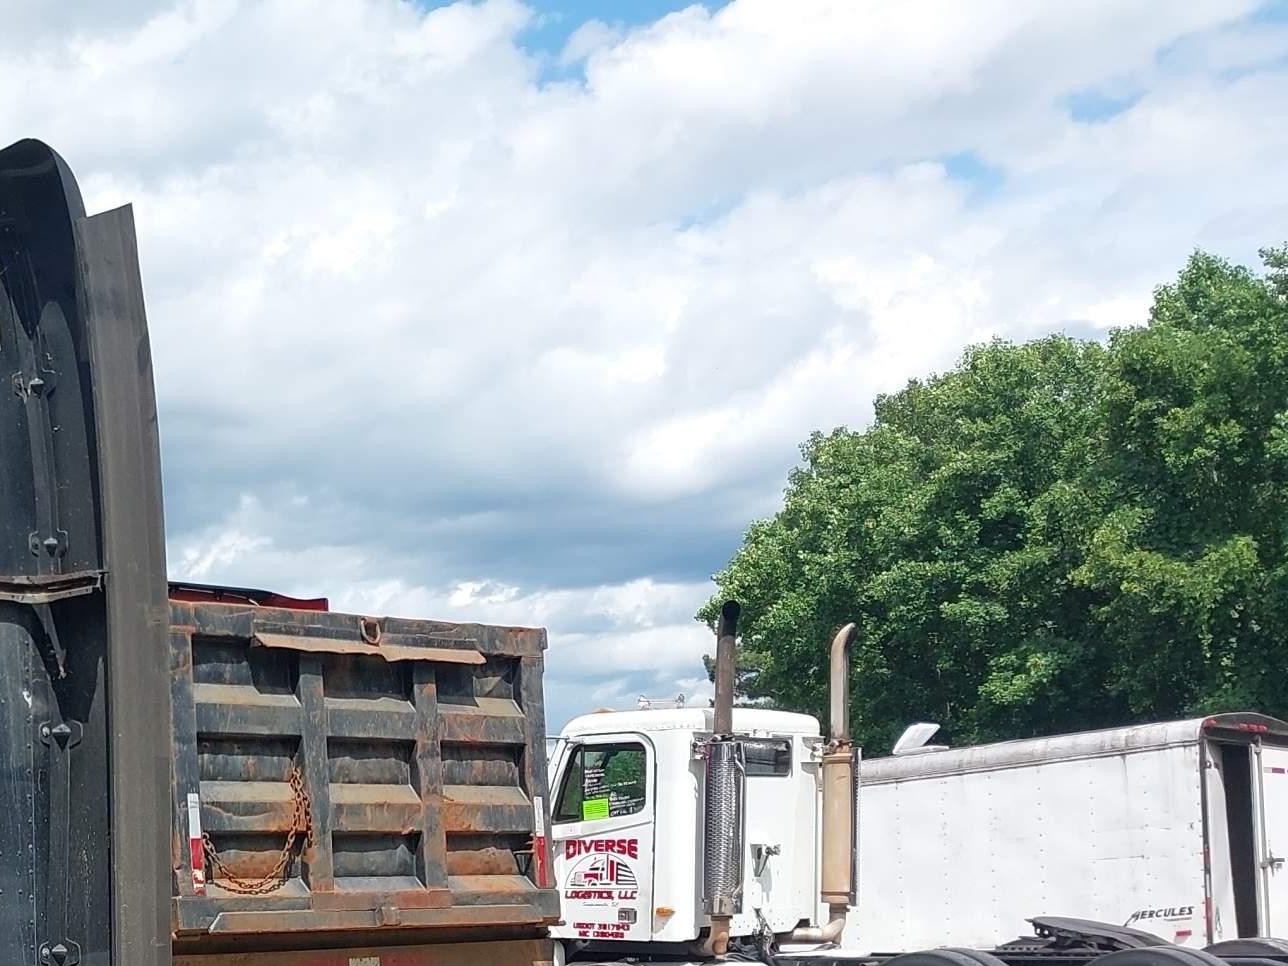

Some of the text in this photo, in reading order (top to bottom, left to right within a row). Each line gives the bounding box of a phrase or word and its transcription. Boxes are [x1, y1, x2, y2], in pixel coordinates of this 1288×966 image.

[565, 838, 638, 860] DIVERSE
[618, 890, 638, 900] LLC
[1123, 906, 1194, 927] HERCULES
